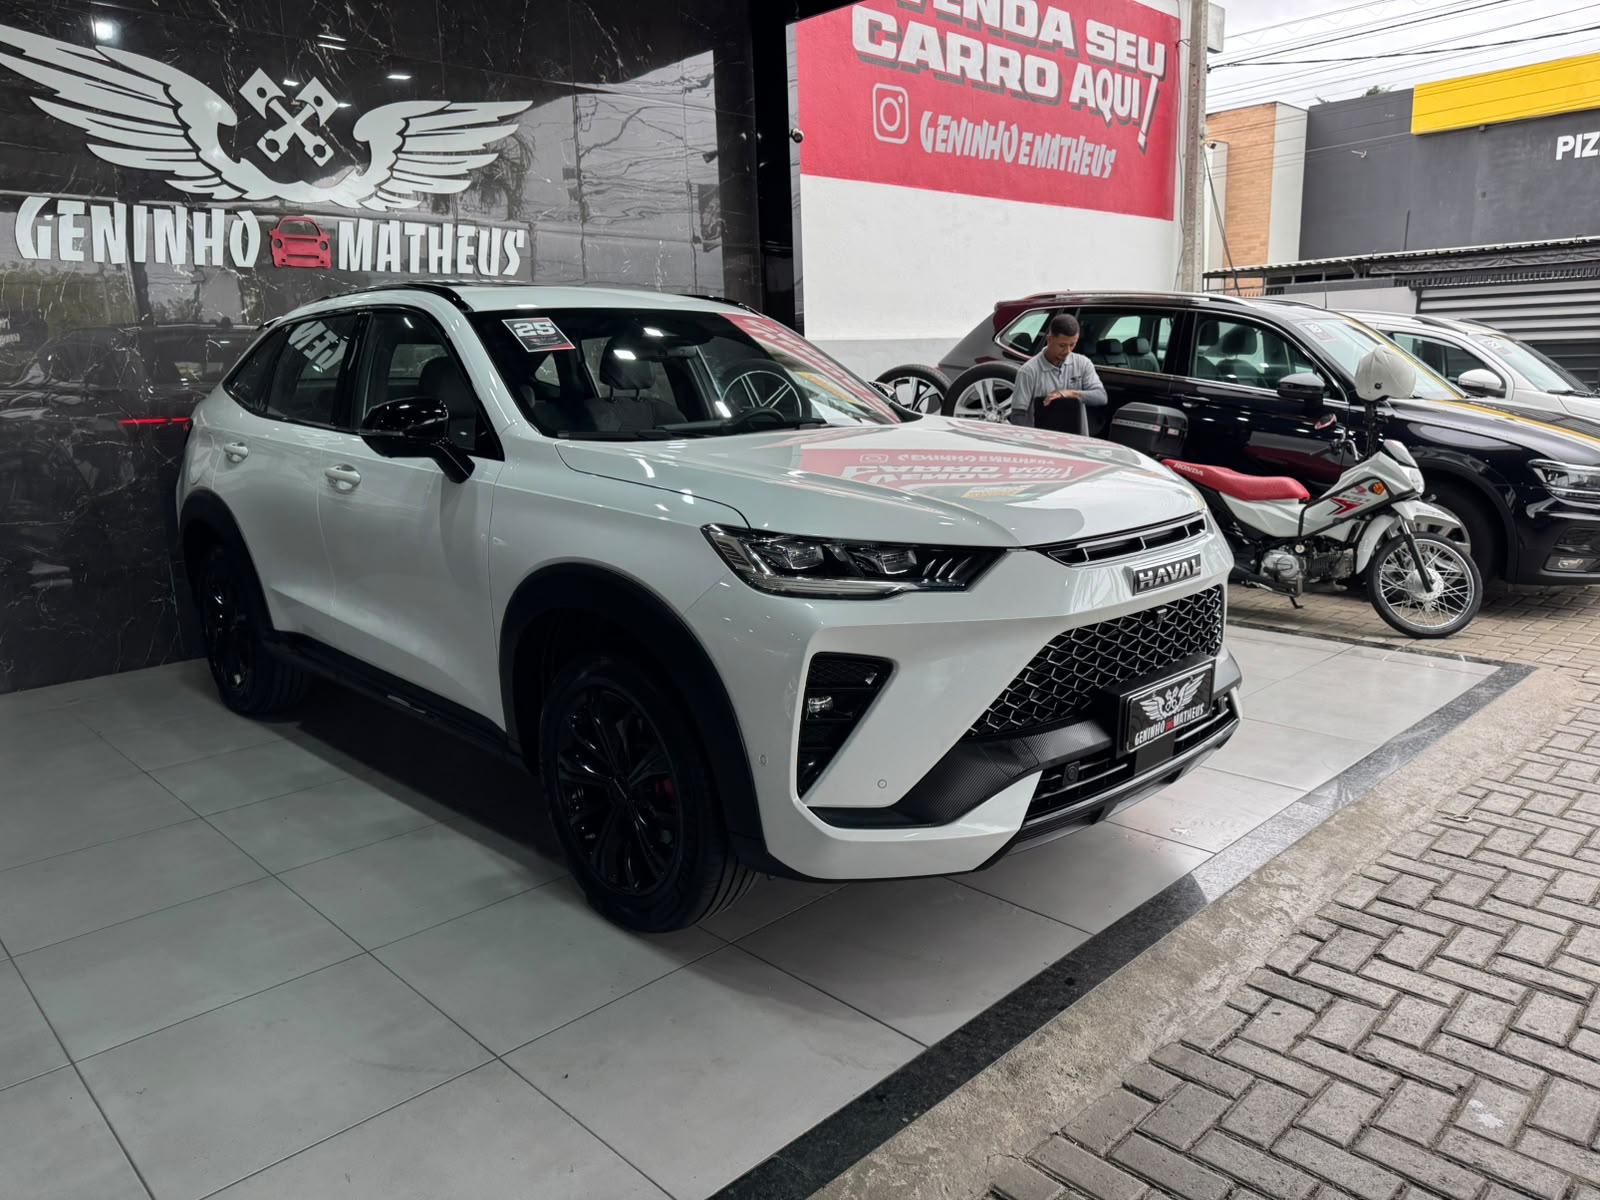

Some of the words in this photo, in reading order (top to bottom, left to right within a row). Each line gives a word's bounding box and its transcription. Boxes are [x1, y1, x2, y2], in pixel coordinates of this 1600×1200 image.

[852, 5, 1058, 98] CARRO
[911, 0, 1075, 49] NDA
[1086, 19, 1165, 76] SEU
[1556, 131, 1600, 160] PIZ
[15, 196, 260, 267] GENINHO
[338, 218, 524, 276] MATHEUS
[513, 322, 556, 337] 25
[1174, 463, 1204, 476] HONDA
[1138, 559, 1200, 589] HAVAL
[1135, 720, 1166, 746] GENINHO
[1174, 702, 1205, 727] MATHEUS
